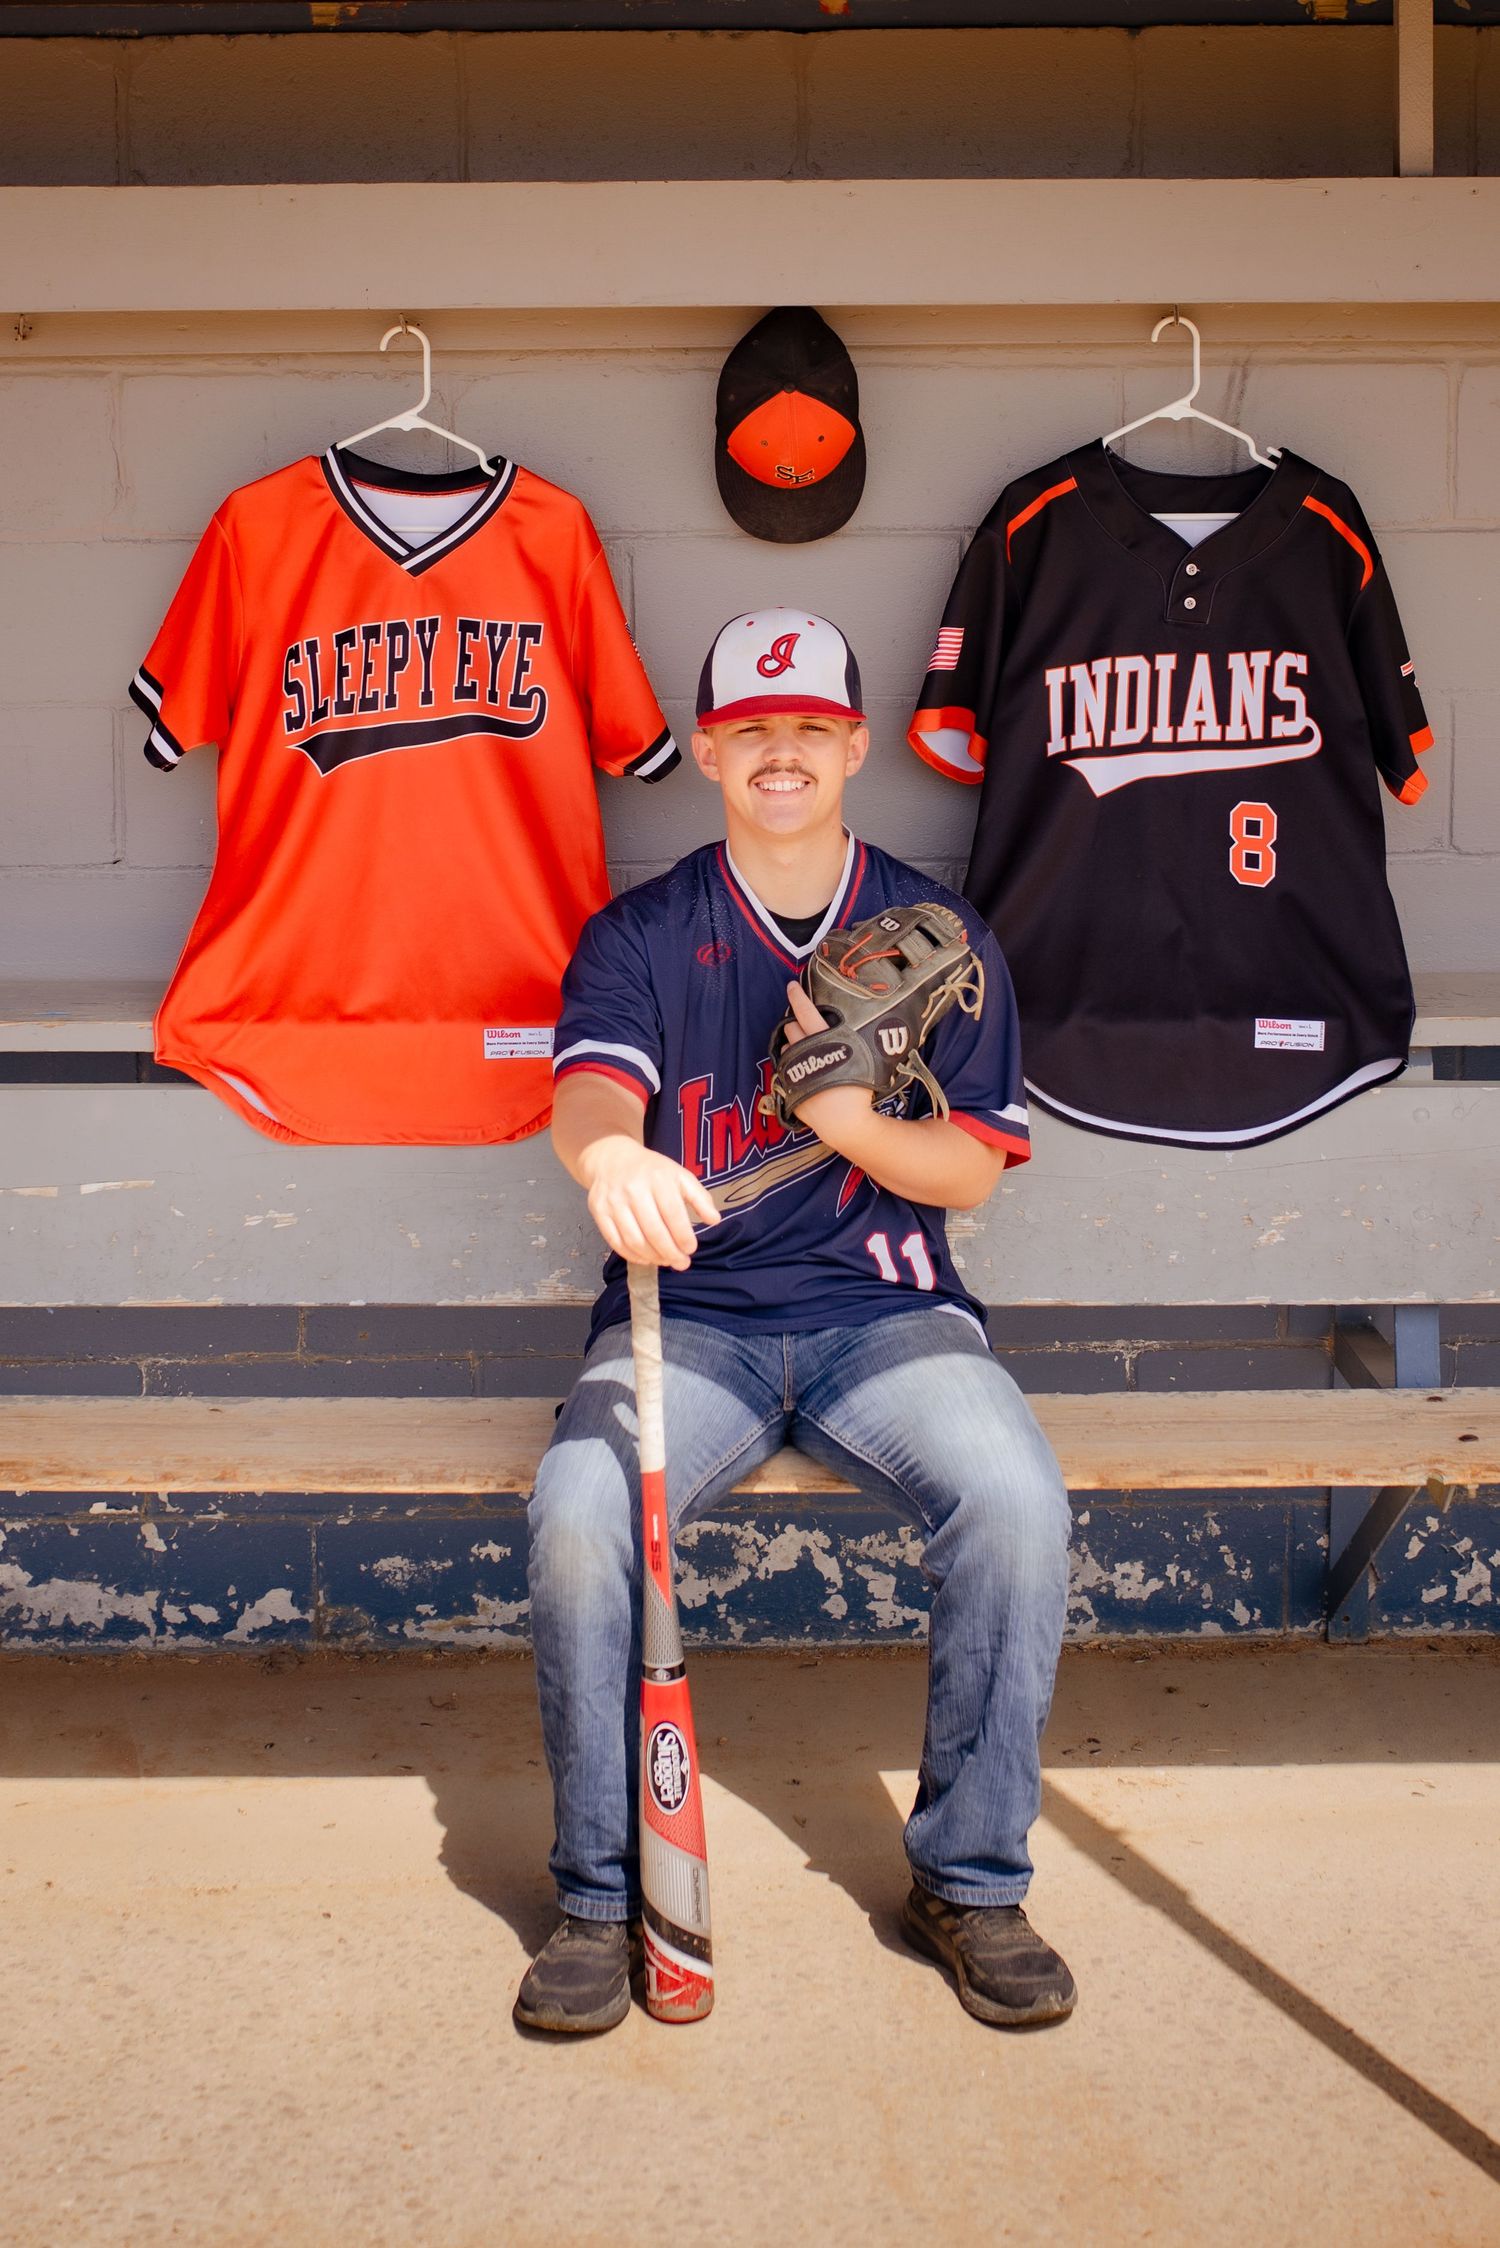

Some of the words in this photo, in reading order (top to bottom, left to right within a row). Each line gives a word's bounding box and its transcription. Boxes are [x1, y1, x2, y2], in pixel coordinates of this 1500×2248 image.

[283, 615, 441, 735] SLEEPY
[453, 616, 548, 712] EYE
[1045, 650, 1308, 757] INDIANS
[1229, 801, 1277, 888] 8
[486, 1030, 521, 1038] Wilson
[877, 1025, 909, 1056] W
[1258, 1020, 1292, 1030] Wilson
[786, 1050, 847, 1084] Wilson
[865, 1232, 937, 1292] 11
[653, 1731, 677, 1809] Slugger
